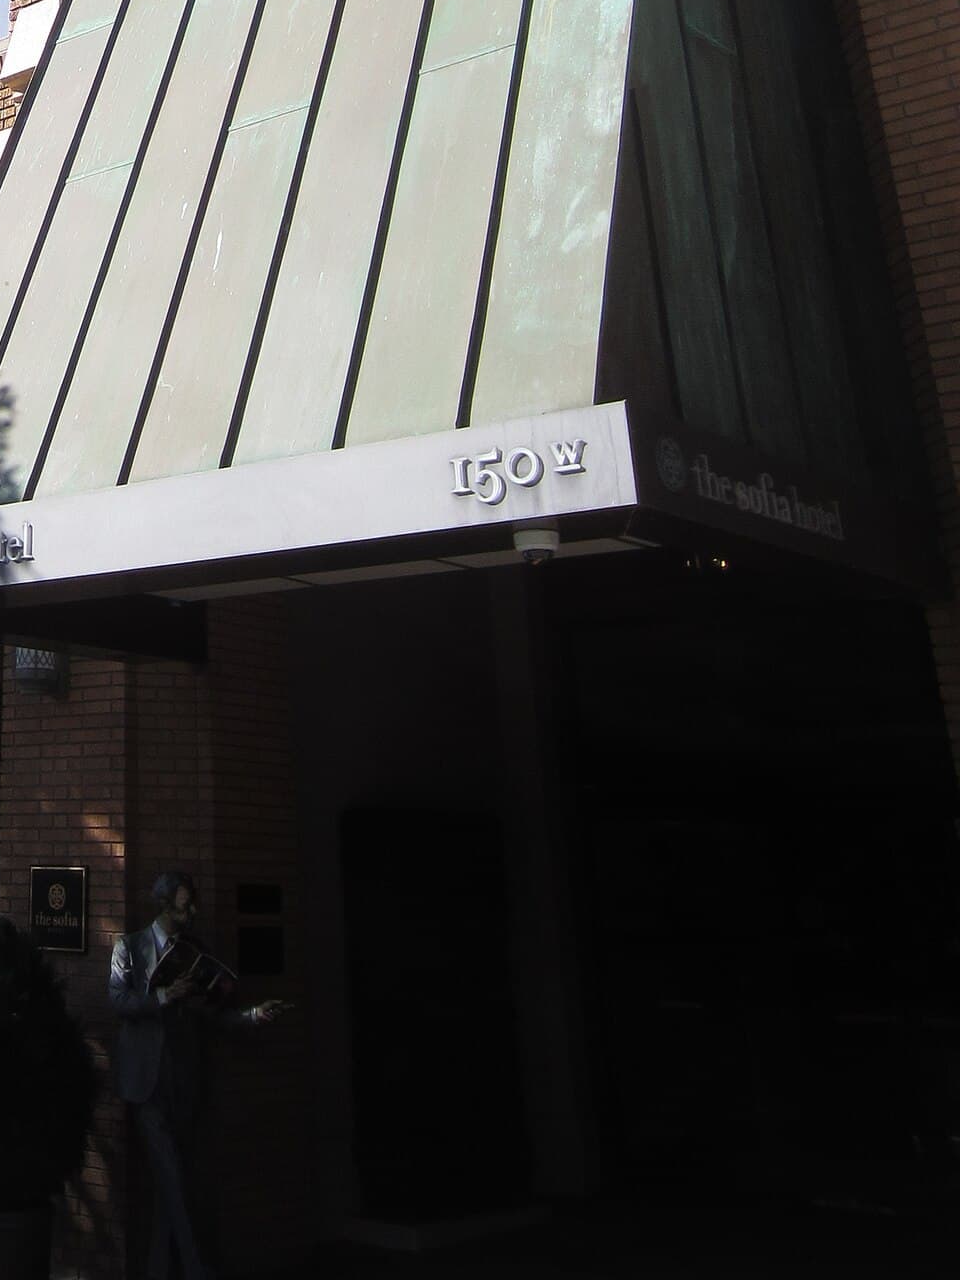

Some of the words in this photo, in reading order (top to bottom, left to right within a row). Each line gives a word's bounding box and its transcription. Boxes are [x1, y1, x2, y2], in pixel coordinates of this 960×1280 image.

[450, 446, 544, 506] 150
[689, 452, 735, 505] the
[736, 472, 794, 524] sofia
[791, 485, 847, 541] hotel
[35, 911, 50, 927] the
[52, 911, 78, 929] sofia
